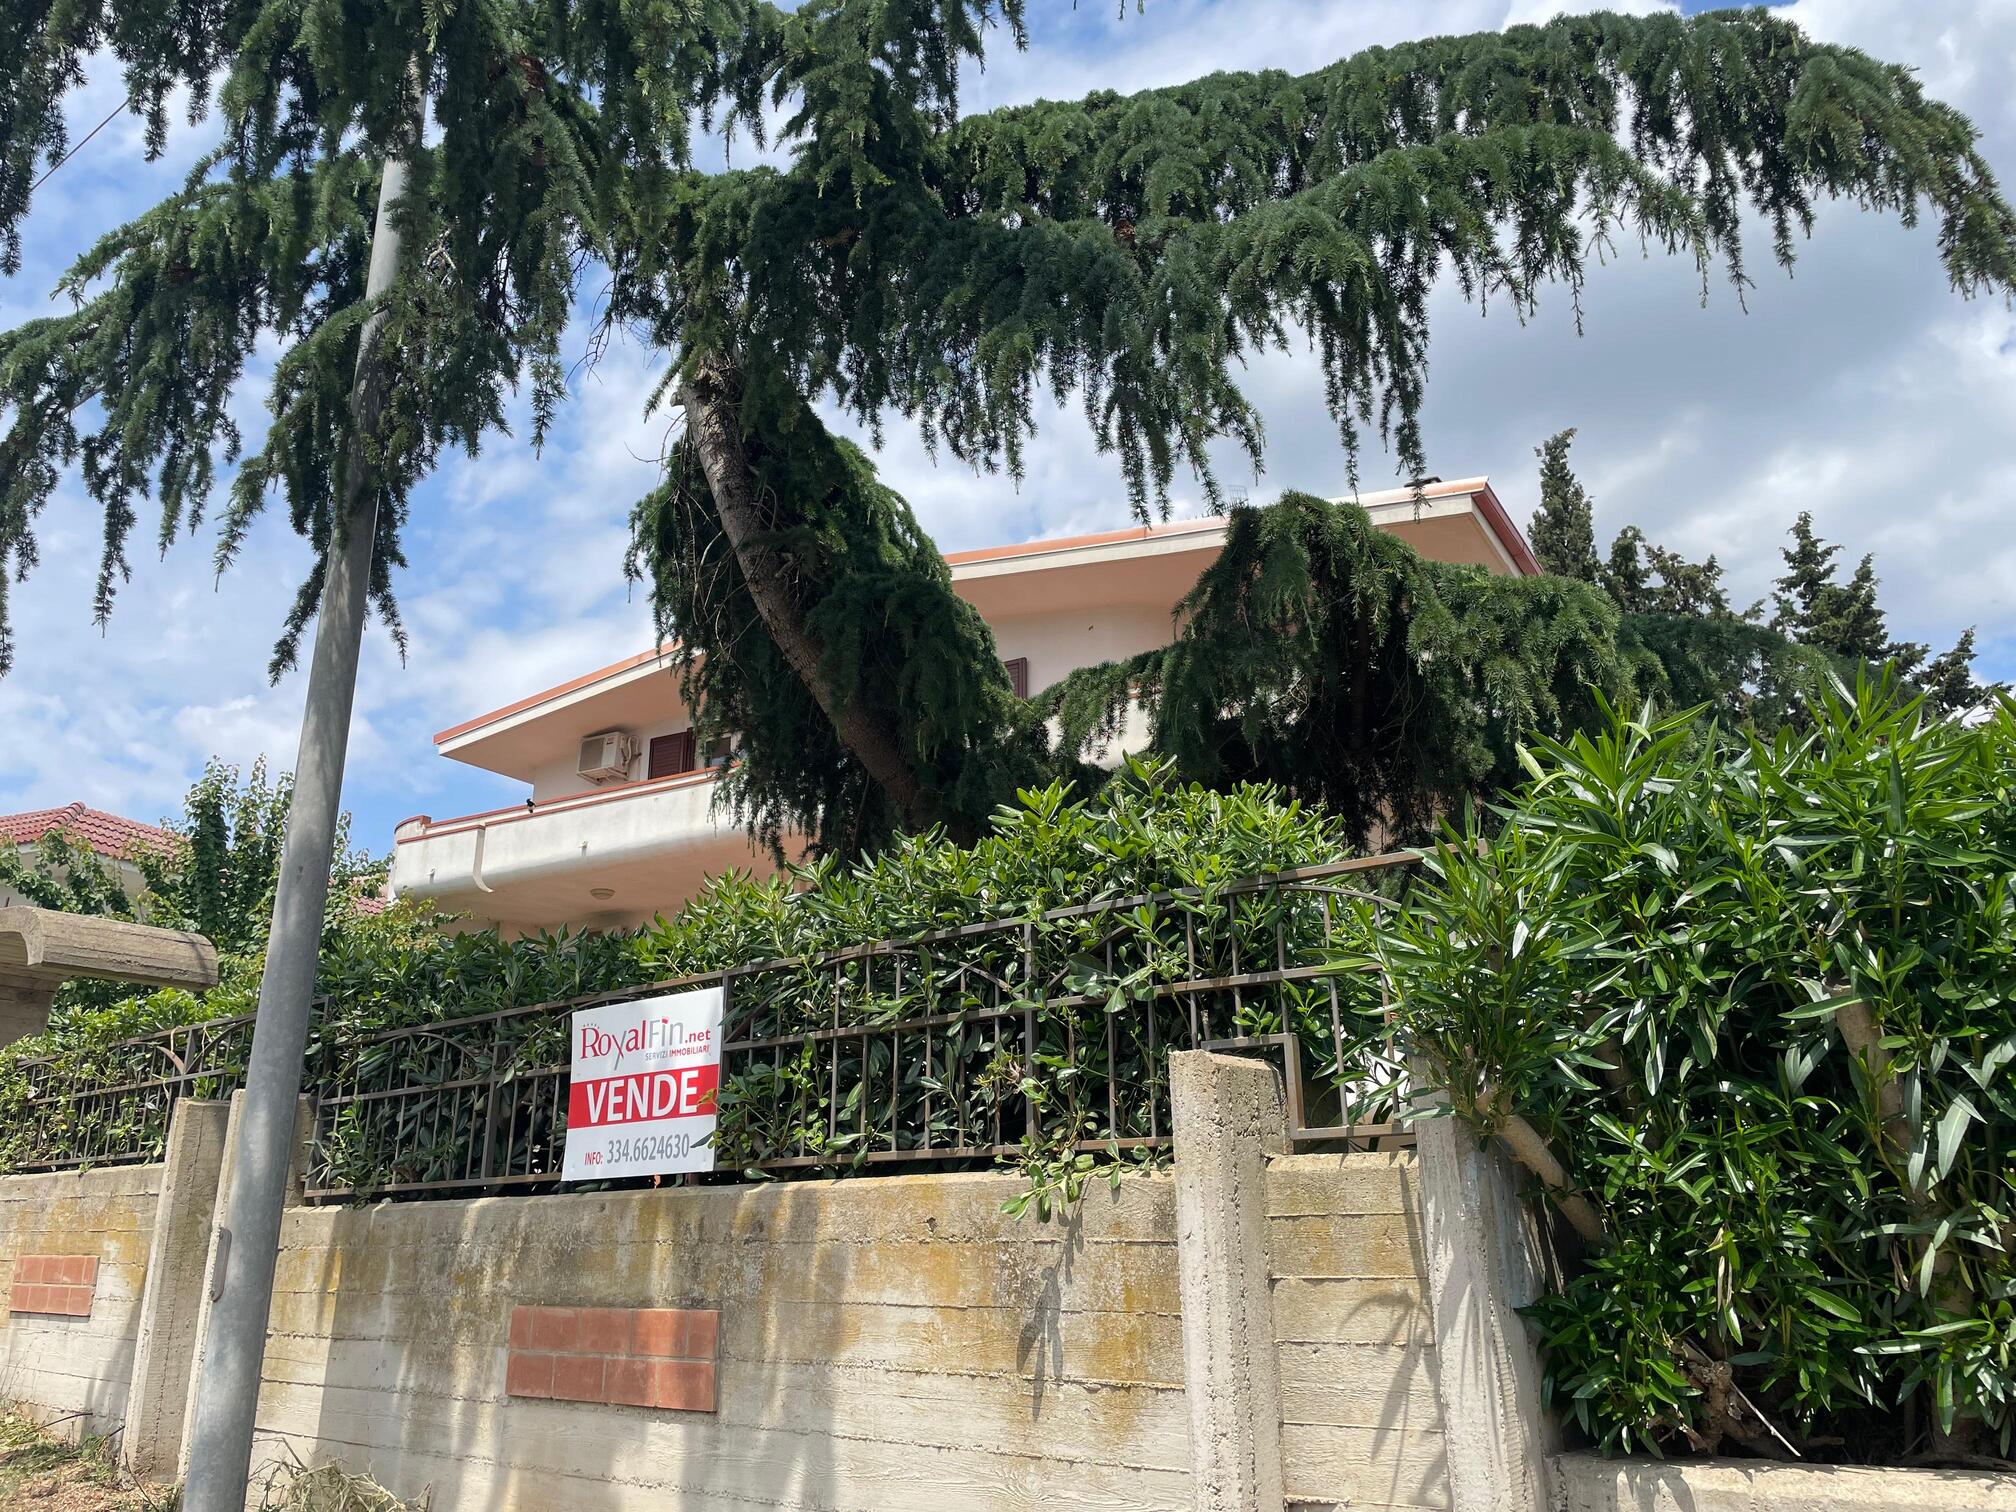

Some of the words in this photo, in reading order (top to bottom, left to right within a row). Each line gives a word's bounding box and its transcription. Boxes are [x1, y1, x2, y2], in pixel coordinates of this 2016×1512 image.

[580, 1018, 711, 1070] RoyalFin.net
[645, 1049, 668, 1061] SERVIZI
[669, 1045, 710, 1057] IMMOBILIARI
[586, 1070, 699, 1123] VENDE
[584, 1152, 603, 1165] INFO:
[606, 1133, 689, 1164] 334.6624630
